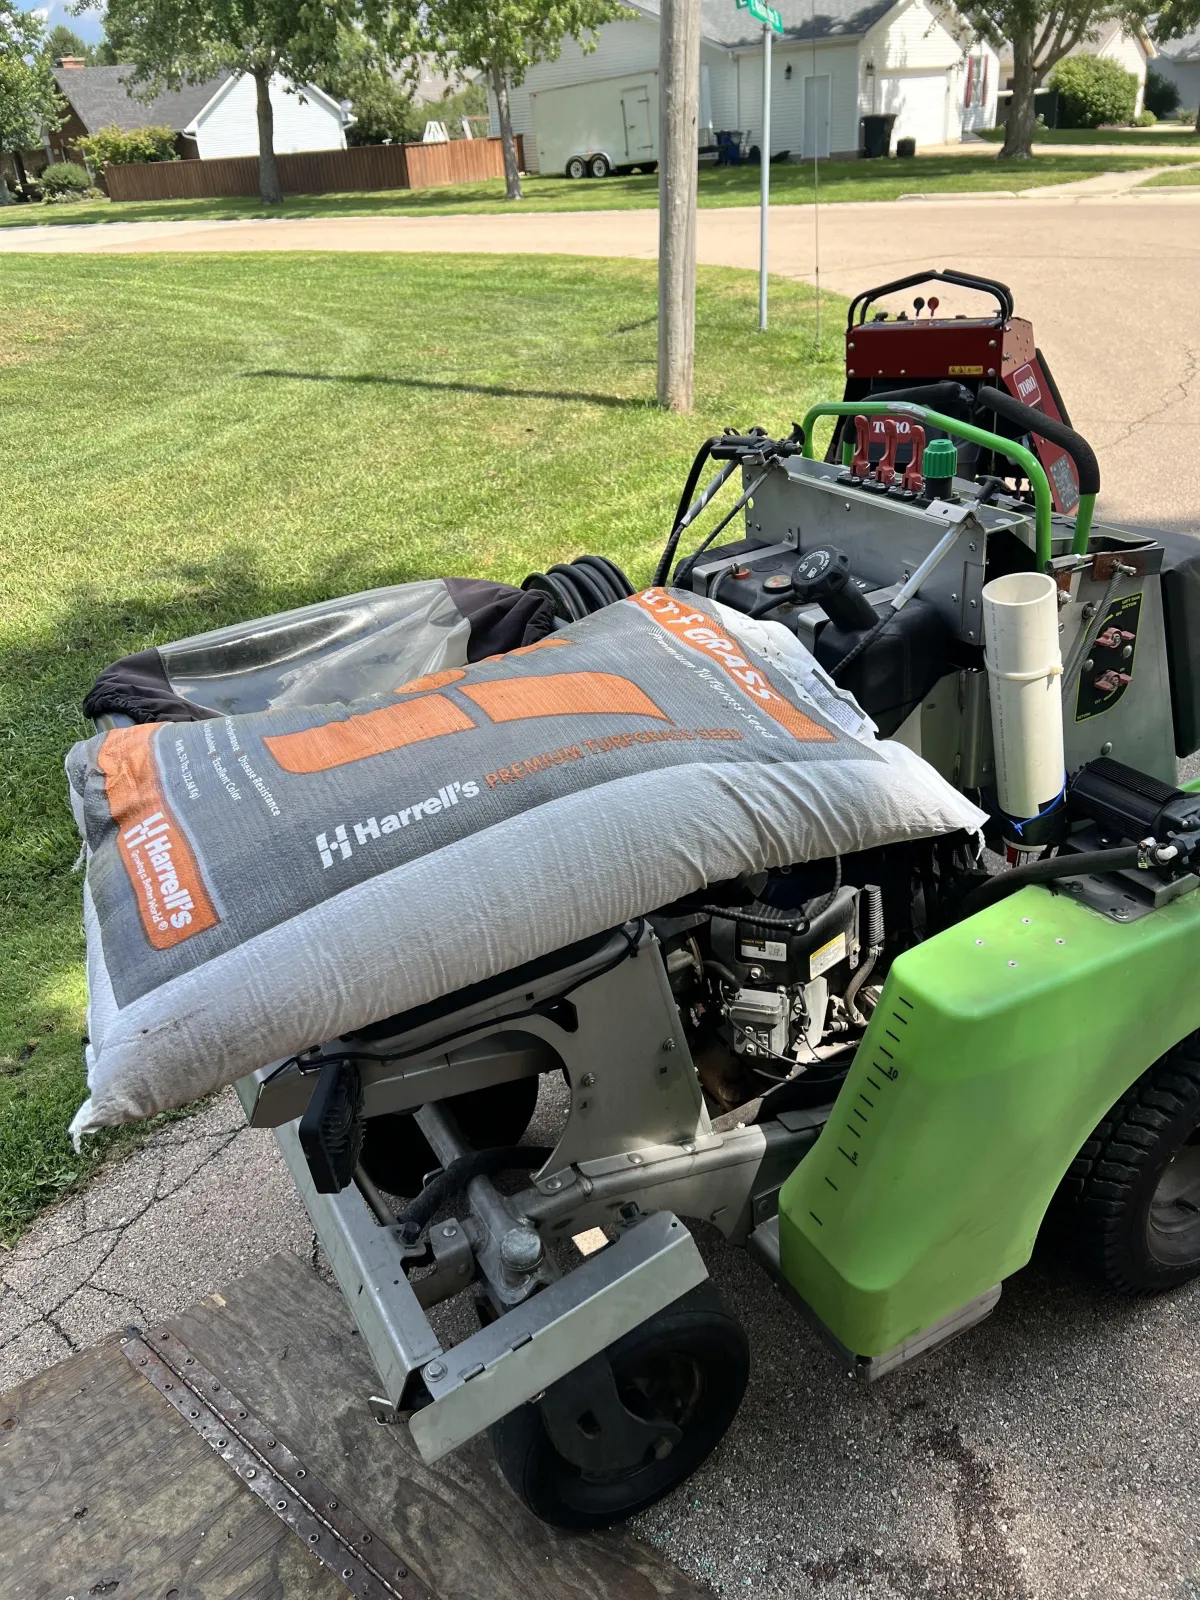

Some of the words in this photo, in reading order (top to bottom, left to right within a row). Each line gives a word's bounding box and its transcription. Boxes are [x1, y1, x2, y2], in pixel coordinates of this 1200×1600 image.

[1017, 376, 1037, 397] TORO
[694, 668, 745, 713] Turfgrass
[742, 712, 778, 739] Seed
[212, 756, 231, 785] Excellent
[226, 782, 242, 801] Color
[238, 755, 257, 780] Disease
[252, 777, 281, 817] Resistance
[353, 781, 480, 845] Harrell's
[484, 744, 585, 790] PREMIUM
[581, 728, 696, 754] TURFGRASS
[695, 727, 745, 741] SEED
[142, 877, 154, 900] Better
[148, 898, 164, 924] World
[144, 835, 195, 929] Harrell's
[888, 1066, 899, 1080] 10
